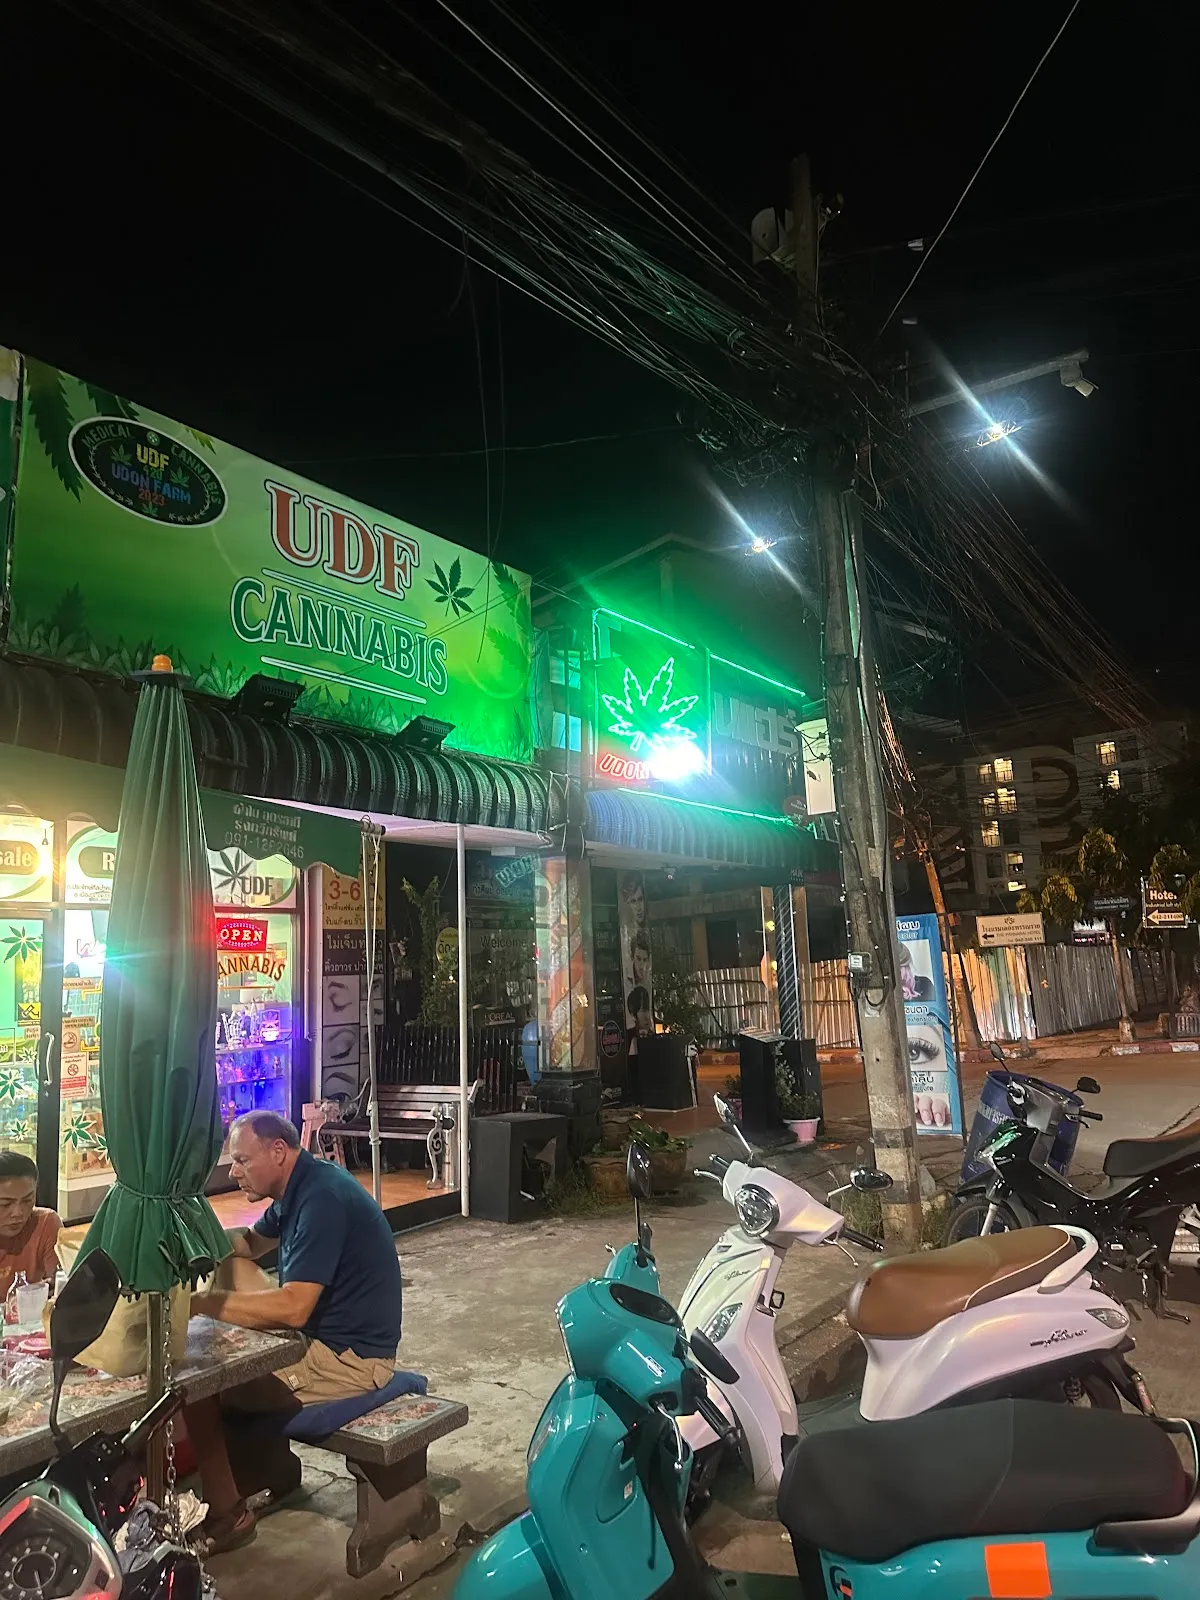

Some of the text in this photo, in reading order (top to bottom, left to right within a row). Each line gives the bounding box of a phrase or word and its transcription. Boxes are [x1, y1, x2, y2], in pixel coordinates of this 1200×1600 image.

[81, 423, 222, 505] MEDICAL CANNABIS
[136, 443, 170, 472] UDF
[111, 462, 192, 505] UDON FARM
[143, 465, 163, 481] 420
[264, 478, 419, 600] UDF
[230, 577, 449, 696] CANNABIS
[241, 876, 275, 896] UDF
[329, 880, 361, 901] 3-6
[220, 928, 264, 942] OPEN
[481, 935, 528, 948] Welcome
[217, 955, 286, 981] ANNABIS
